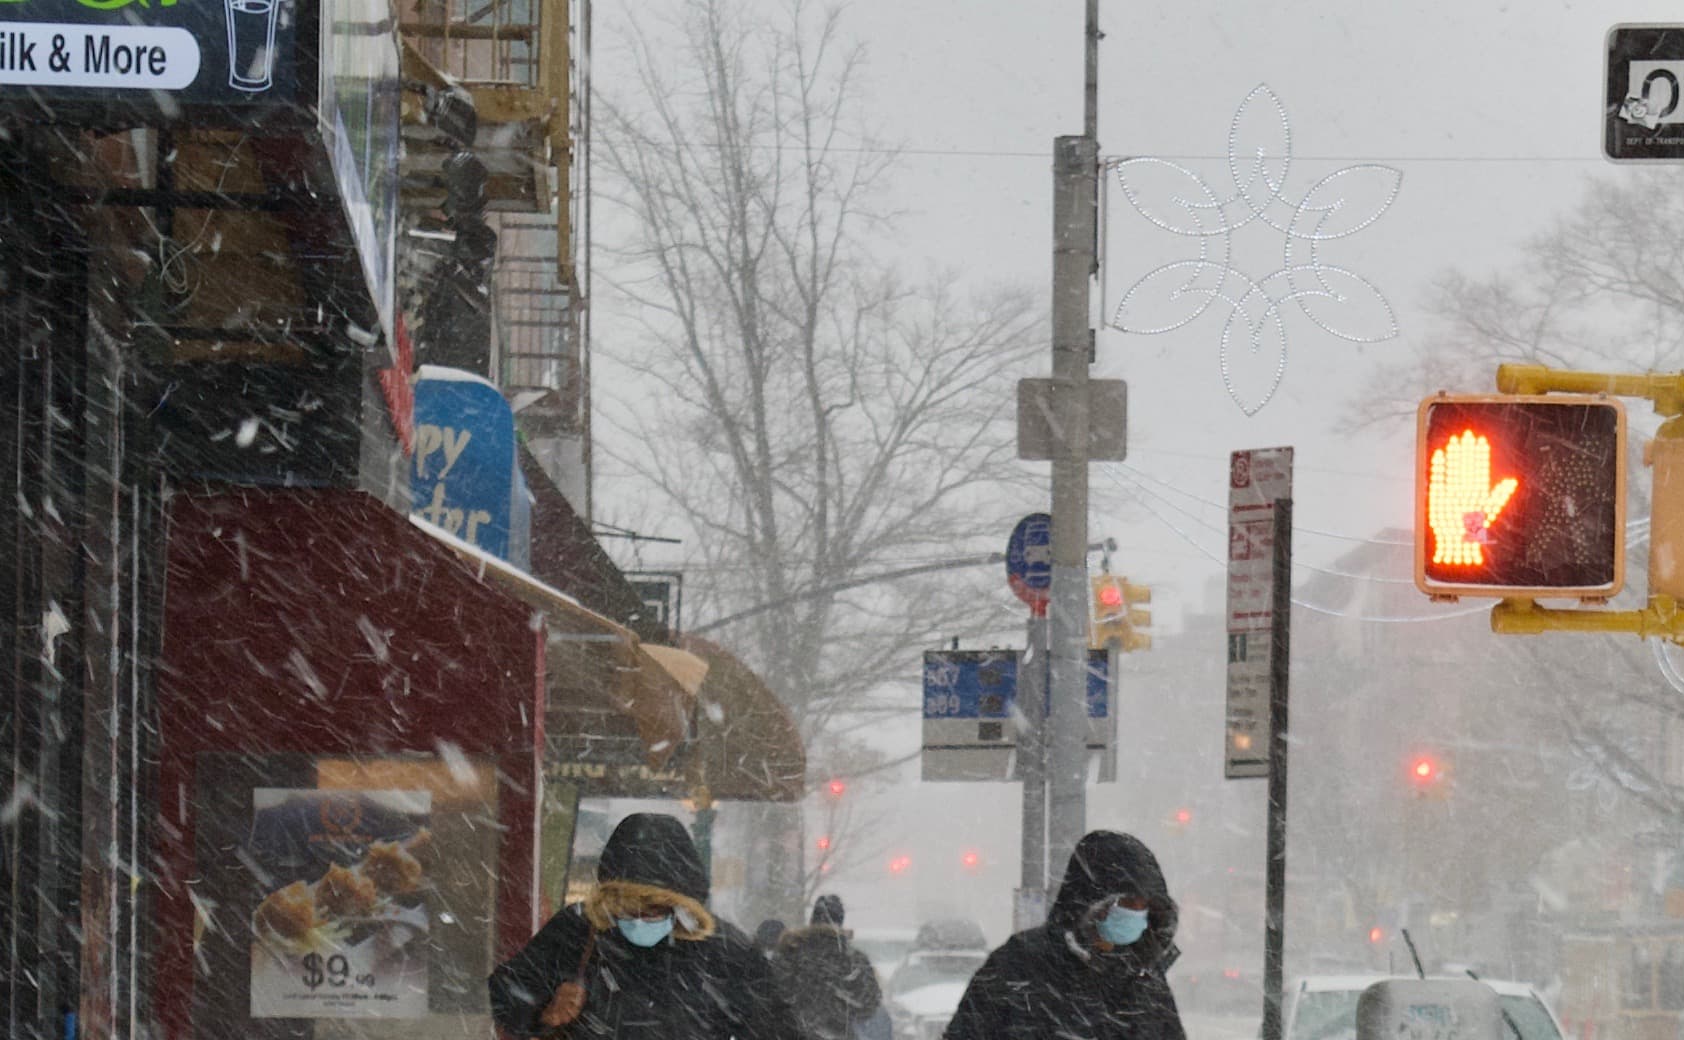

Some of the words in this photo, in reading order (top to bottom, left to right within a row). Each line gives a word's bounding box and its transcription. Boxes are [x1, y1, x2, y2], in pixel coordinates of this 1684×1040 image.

[0, 32, 37, 72] ilk
[48, 33, 72, 73] &
[84, 34, 168, 76] More
[418, 482, 492, 545] ter
